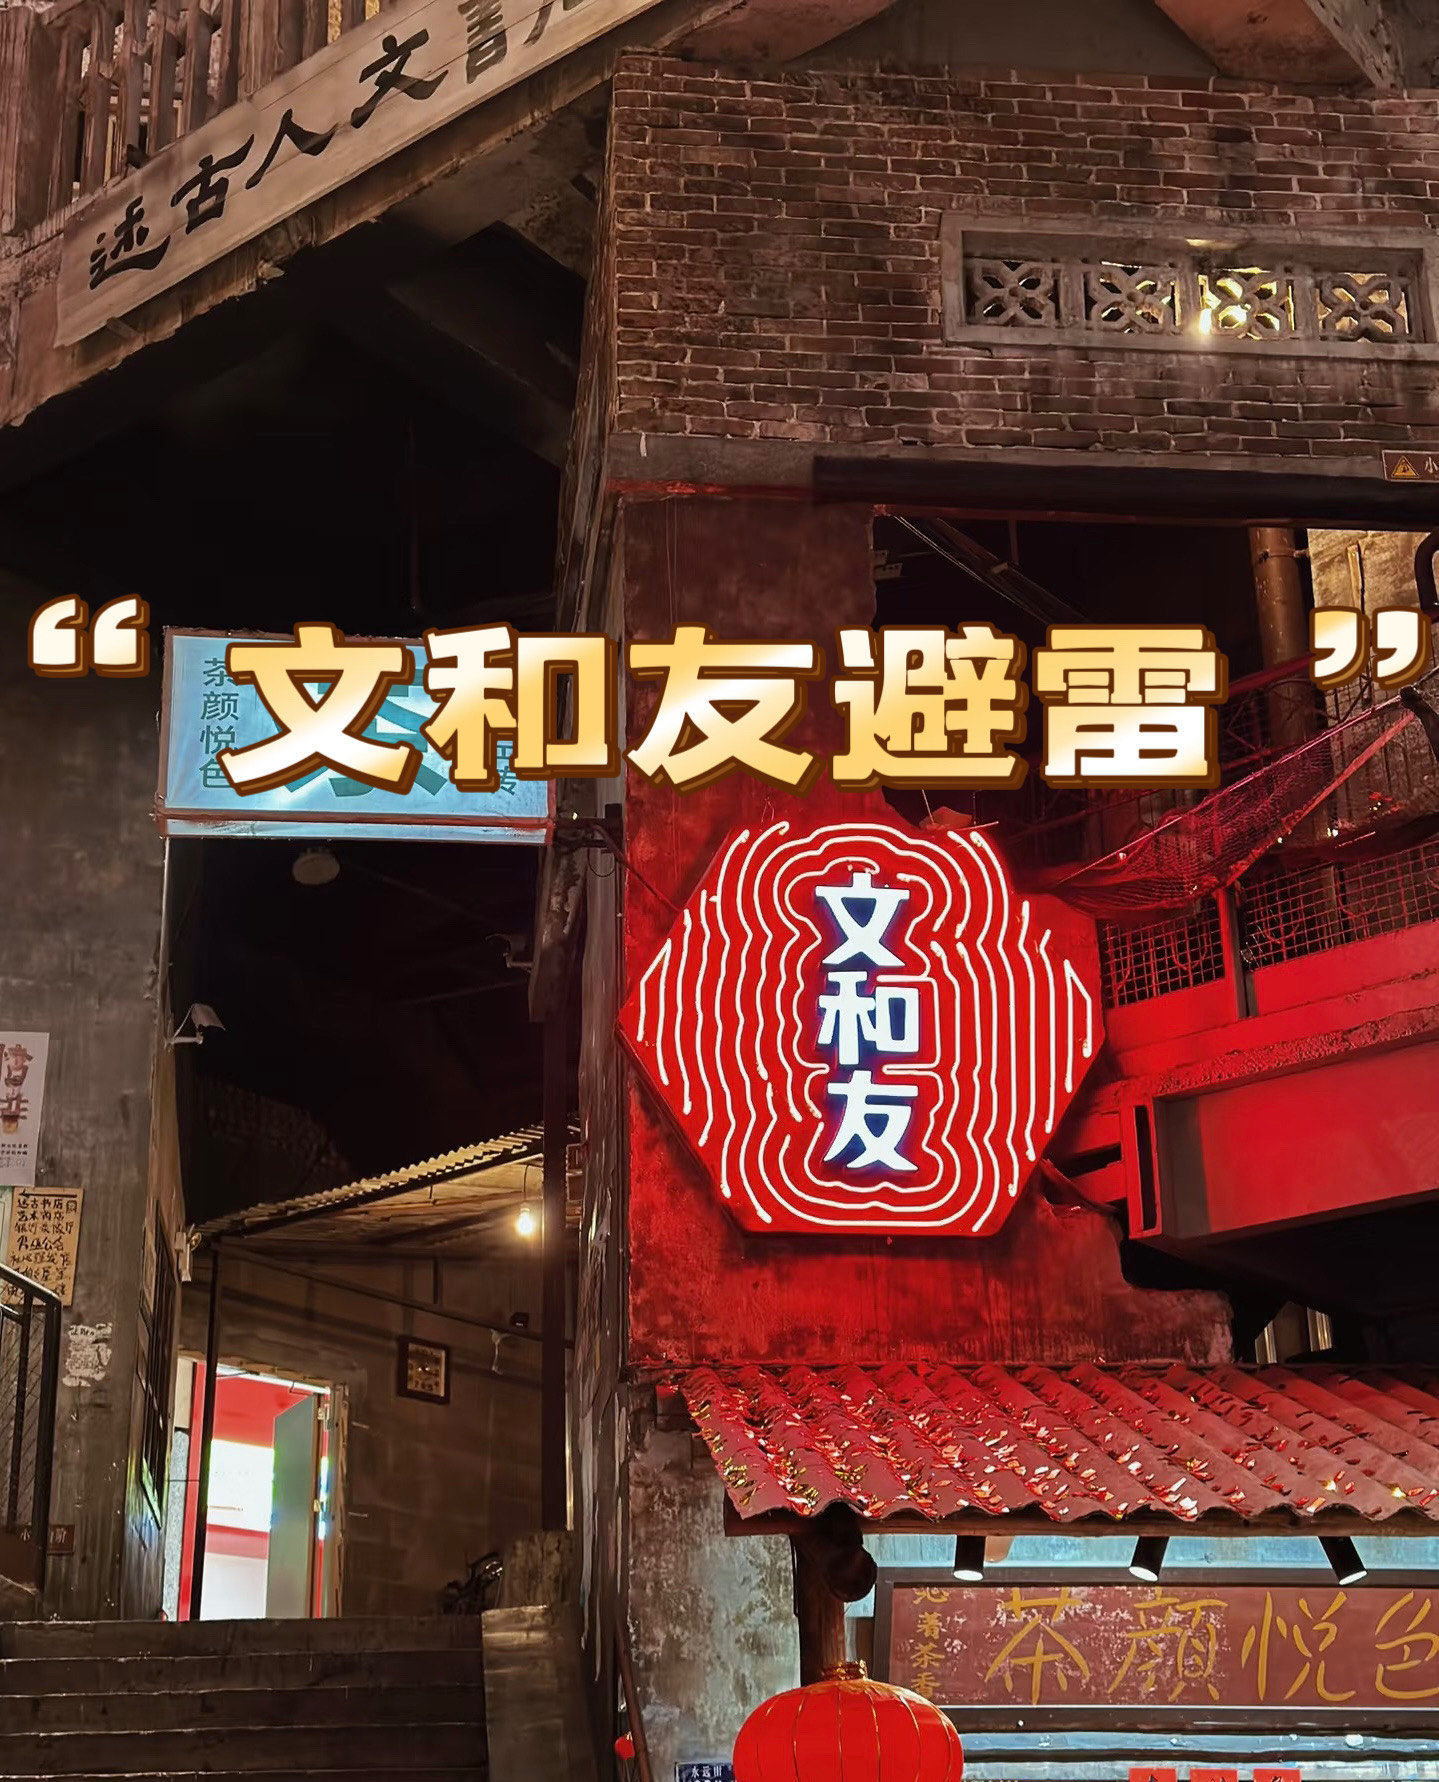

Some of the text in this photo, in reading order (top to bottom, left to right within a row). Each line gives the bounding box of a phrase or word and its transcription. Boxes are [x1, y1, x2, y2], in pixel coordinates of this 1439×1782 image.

[90, 0, 586, 290] 述古人文書
[199, 657, 239, 788] 茶颜悦色
[815, 872, 919, 1172] 文和友
